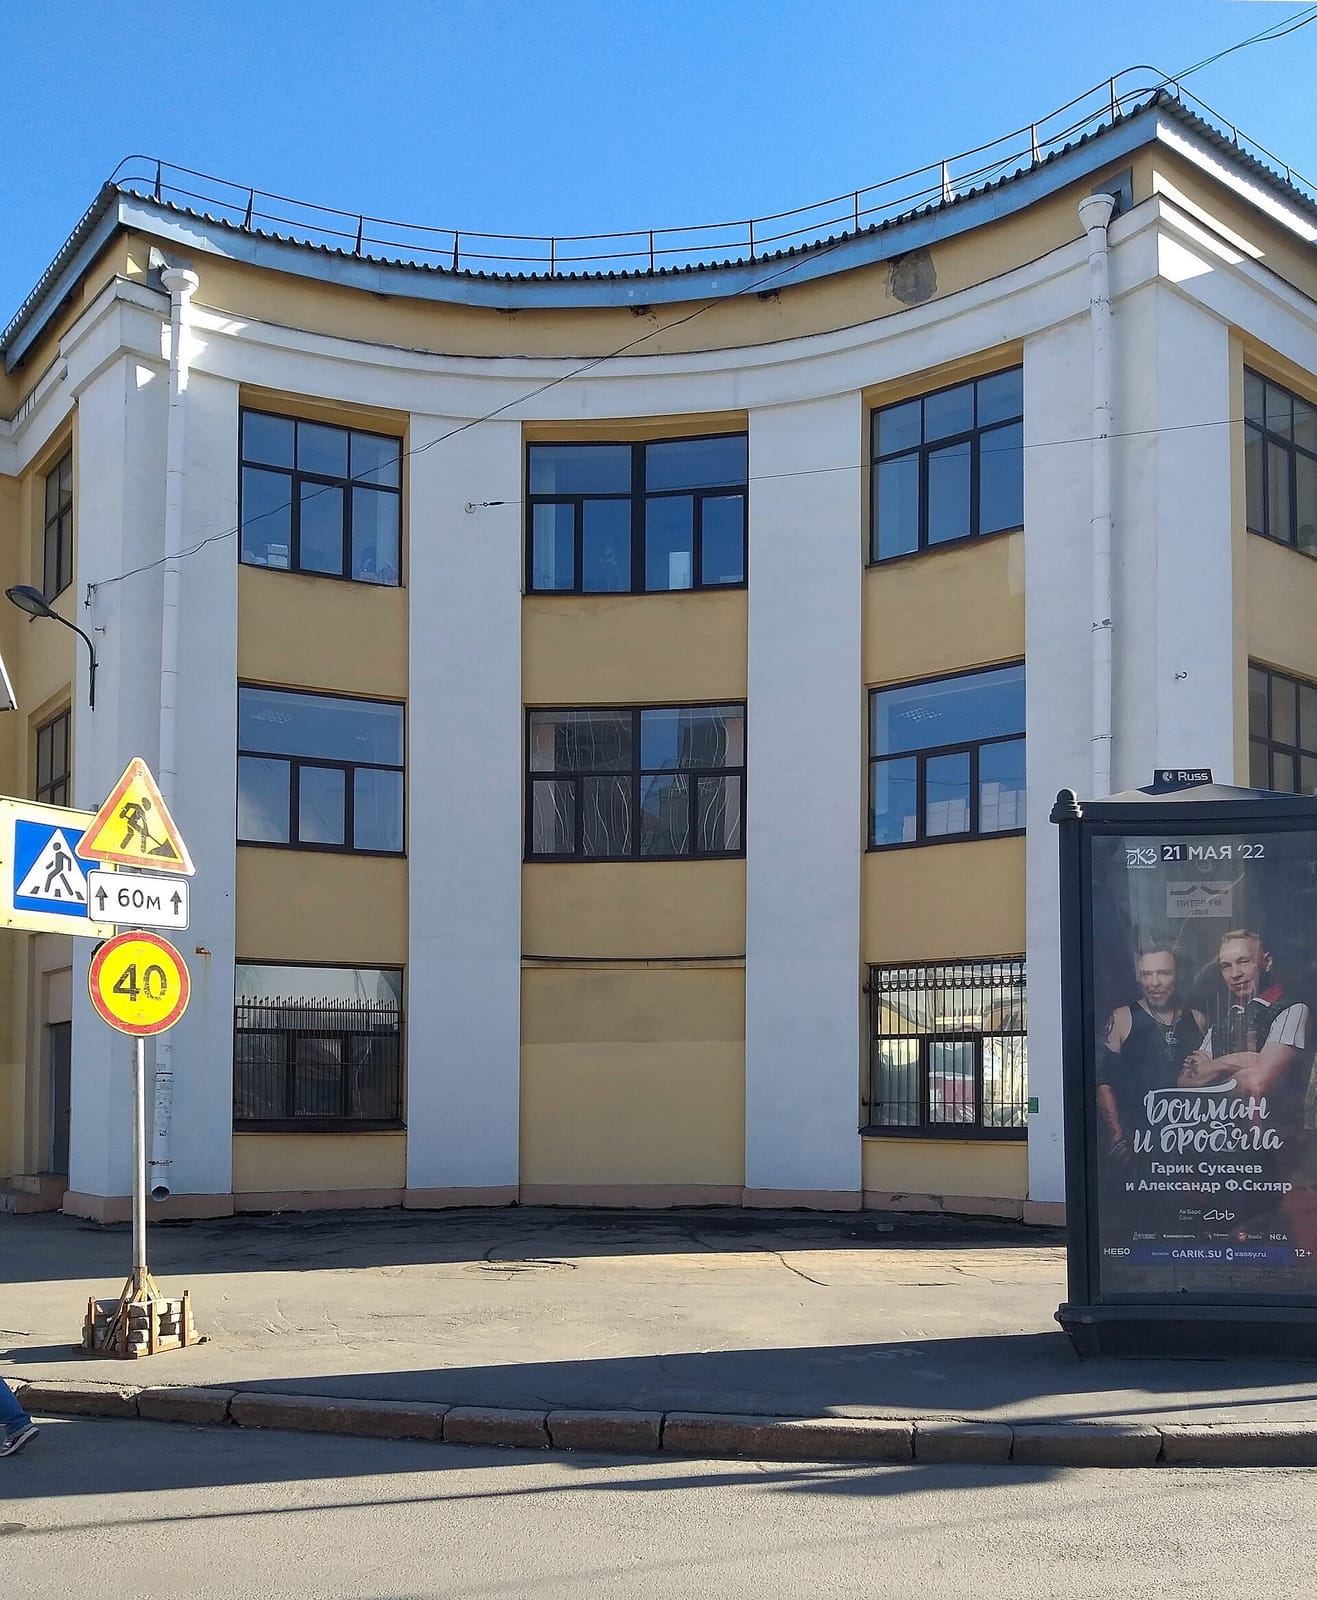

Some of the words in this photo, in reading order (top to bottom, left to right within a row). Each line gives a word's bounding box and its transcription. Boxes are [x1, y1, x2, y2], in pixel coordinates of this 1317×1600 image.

[1177, 771, 1209, 781] Russ
[1125, 847, 1158, 865] БКЗ
[1163, 845, 1181, 860] 21
[1188, 845, 1232, 860] МАЯ
[113, 963, 167, 1002] 40
[1160, 1120, 1285, 1154] бродяга
[1151, 1162, 1195, 1176] Гарик
[1198, 1162, 1263, 1176] Сукачев
[1125, 1182, 1134, 1191] и
[1138, 1179, 1221, 1193] Александр
[1225, 1179, 1292, 1194] Ф.Скляр
[1103, 1247, 1131, 1255] НЕБО
[1171, 1249, 1222, 1258] GARIK.SU
[1234, 1250, 1267, 1259] kassy.ru
[1294, 1248, 1313, 1257] 12+
